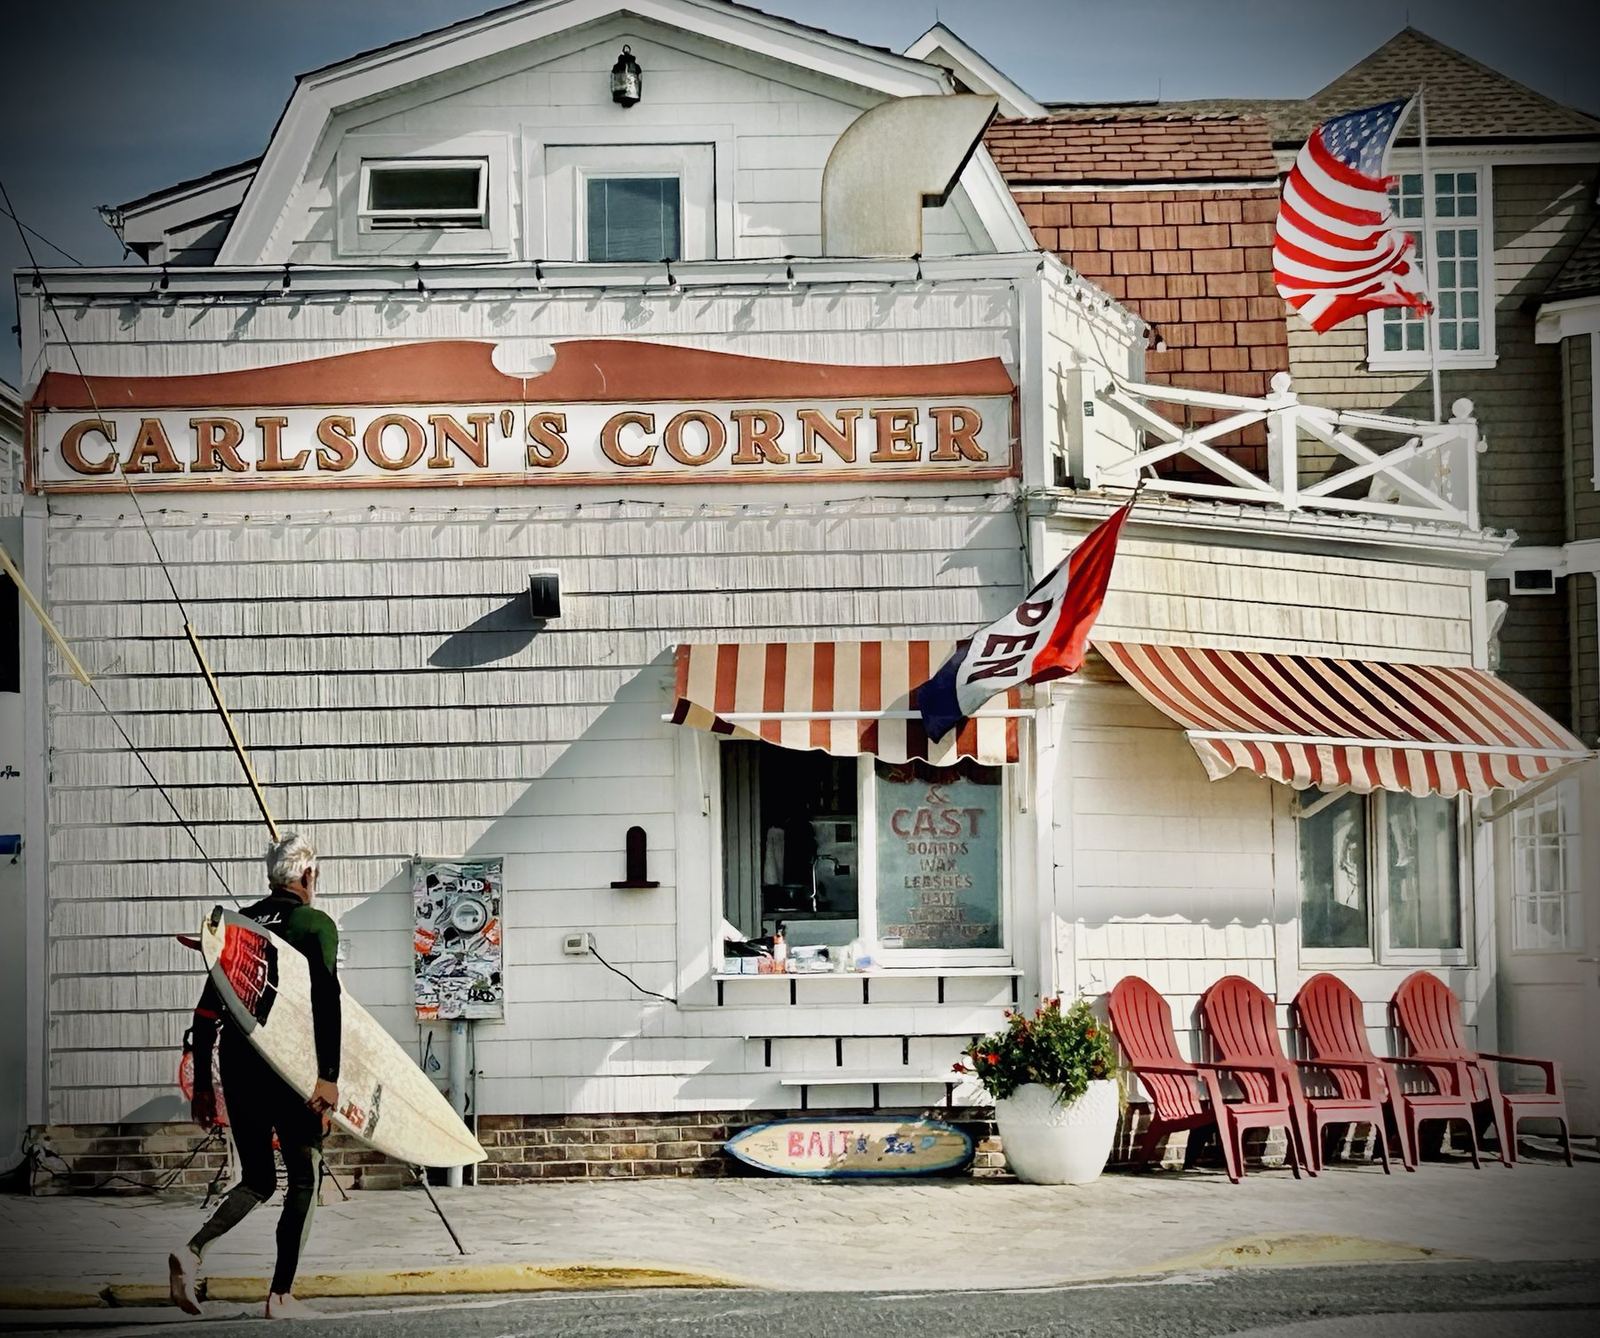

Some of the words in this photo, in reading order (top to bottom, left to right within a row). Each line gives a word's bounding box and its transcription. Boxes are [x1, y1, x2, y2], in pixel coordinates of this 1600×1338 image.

[60, 408, 569, 475] CARLSON'S
[600, 406, 989, 467] CORNER
[966, 568, 1058, 685] PEN
[925, 784, 950, 804] &
[890, 807, 985, 839] CAST
[906, 840, 969, 856] BOARDS
[920, 857, 957, 872] WAX
[904, 873, 973, 889] LEASHES
[787, 1130, 853, 1158] BAIT
